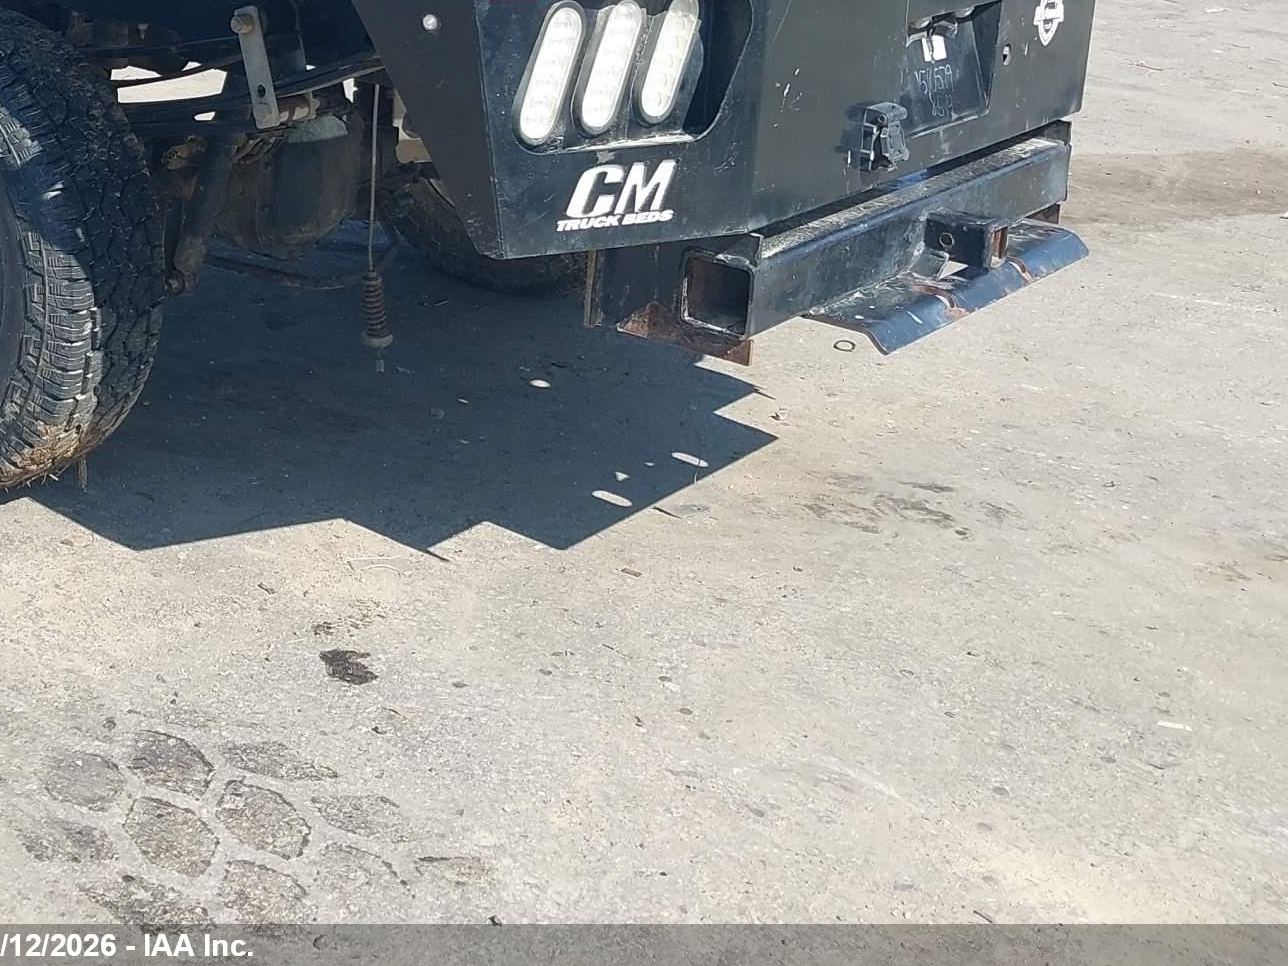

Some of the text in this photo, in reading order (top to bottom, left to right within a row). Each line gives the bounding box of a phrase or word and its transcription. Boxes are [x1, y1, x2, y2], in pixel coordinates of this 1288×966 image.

[566, 159, 676, 218] CM
[556, 209, 674, 231] TRUCK BEDS
